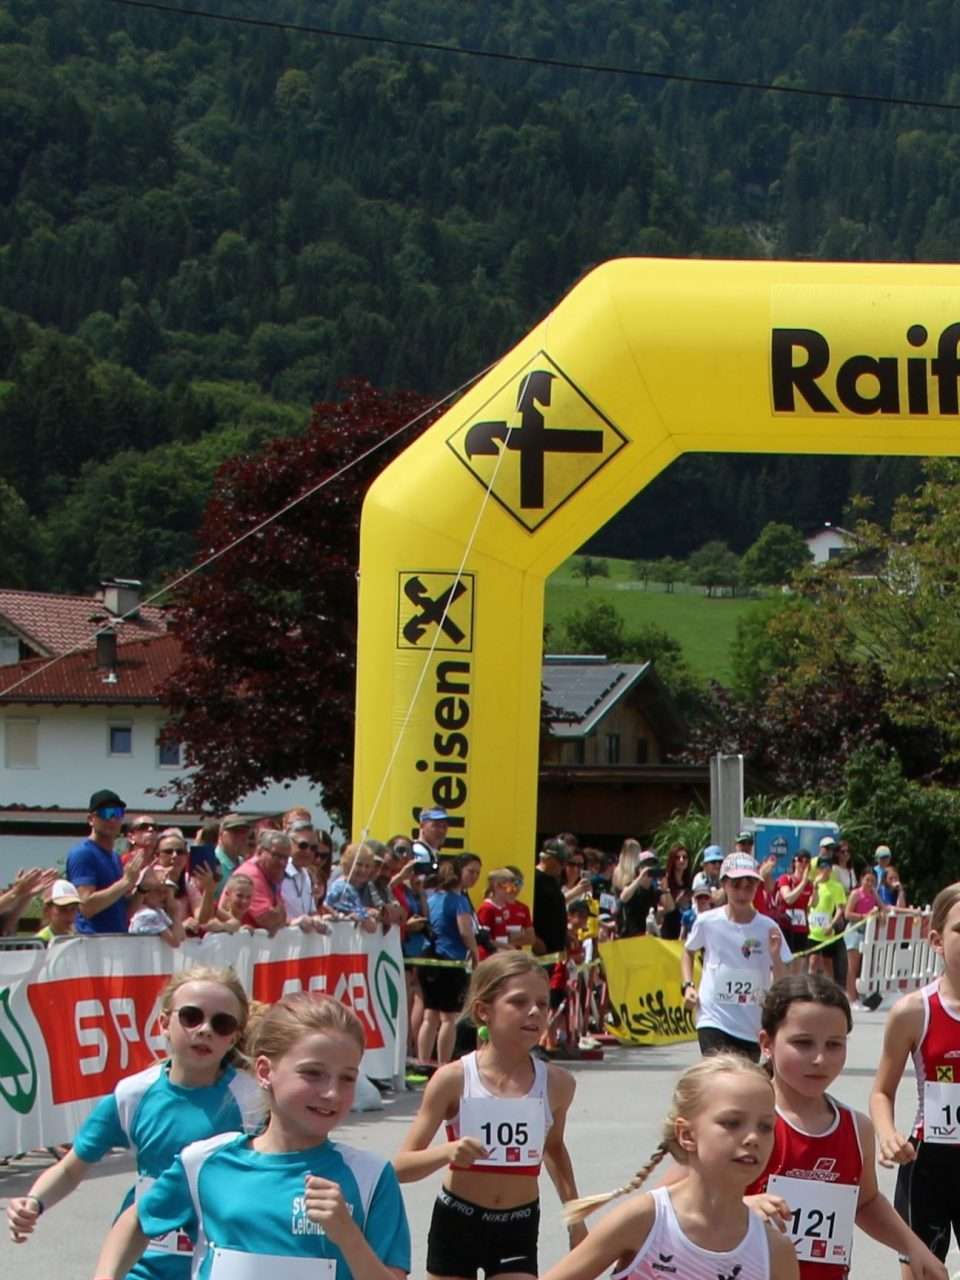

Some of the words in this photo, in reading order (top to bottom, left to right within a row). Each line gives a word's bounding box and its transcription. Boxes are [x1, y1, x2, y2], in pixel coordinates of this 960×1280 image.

[727, 982, 752, 994] 122
[75, 998, 168, 1076] SPA
[481, 1122, 528, 1145] 105
[790, 1208, 836, 1239] 121
